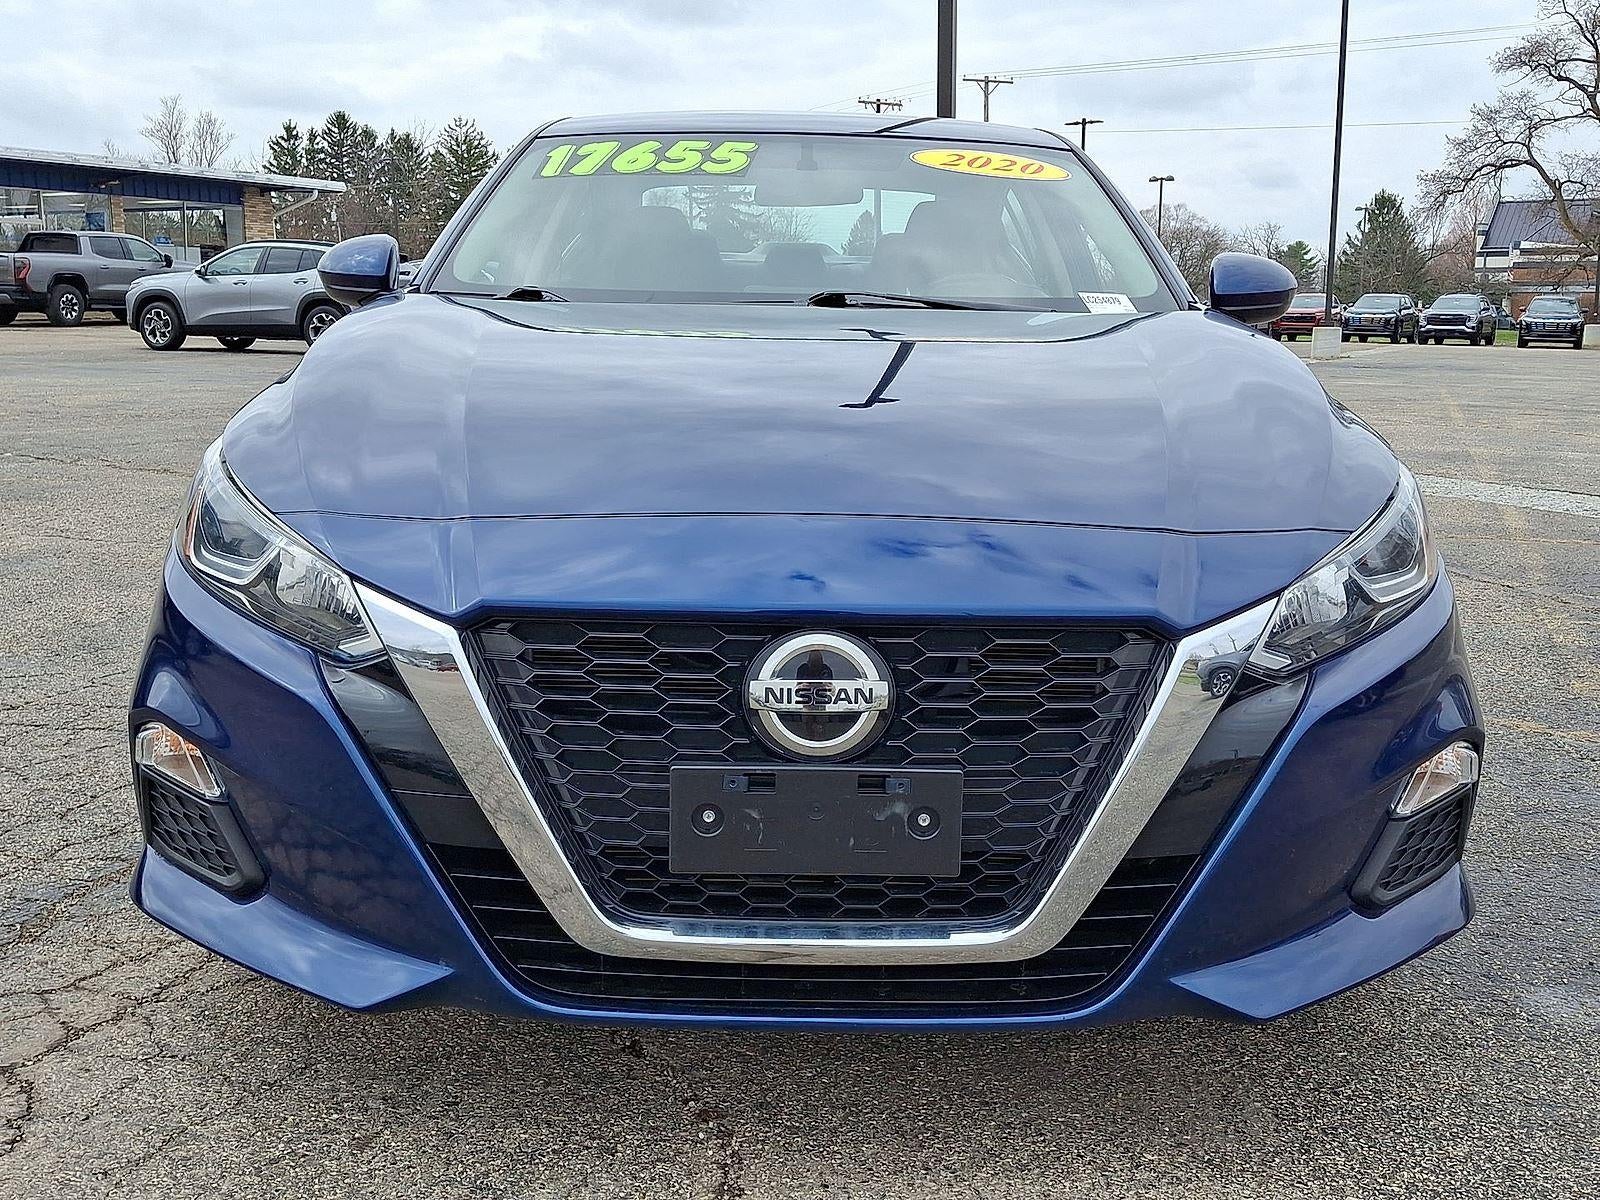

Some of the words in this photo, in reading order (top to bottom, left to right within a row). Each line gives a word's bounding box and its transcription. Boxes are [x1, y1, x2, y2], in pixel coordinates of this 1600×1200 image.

[540, 140, 759, 177] 17655
[939, 153, 1045, 175] 2020
[764, 687, 874, 705] NISSAN
